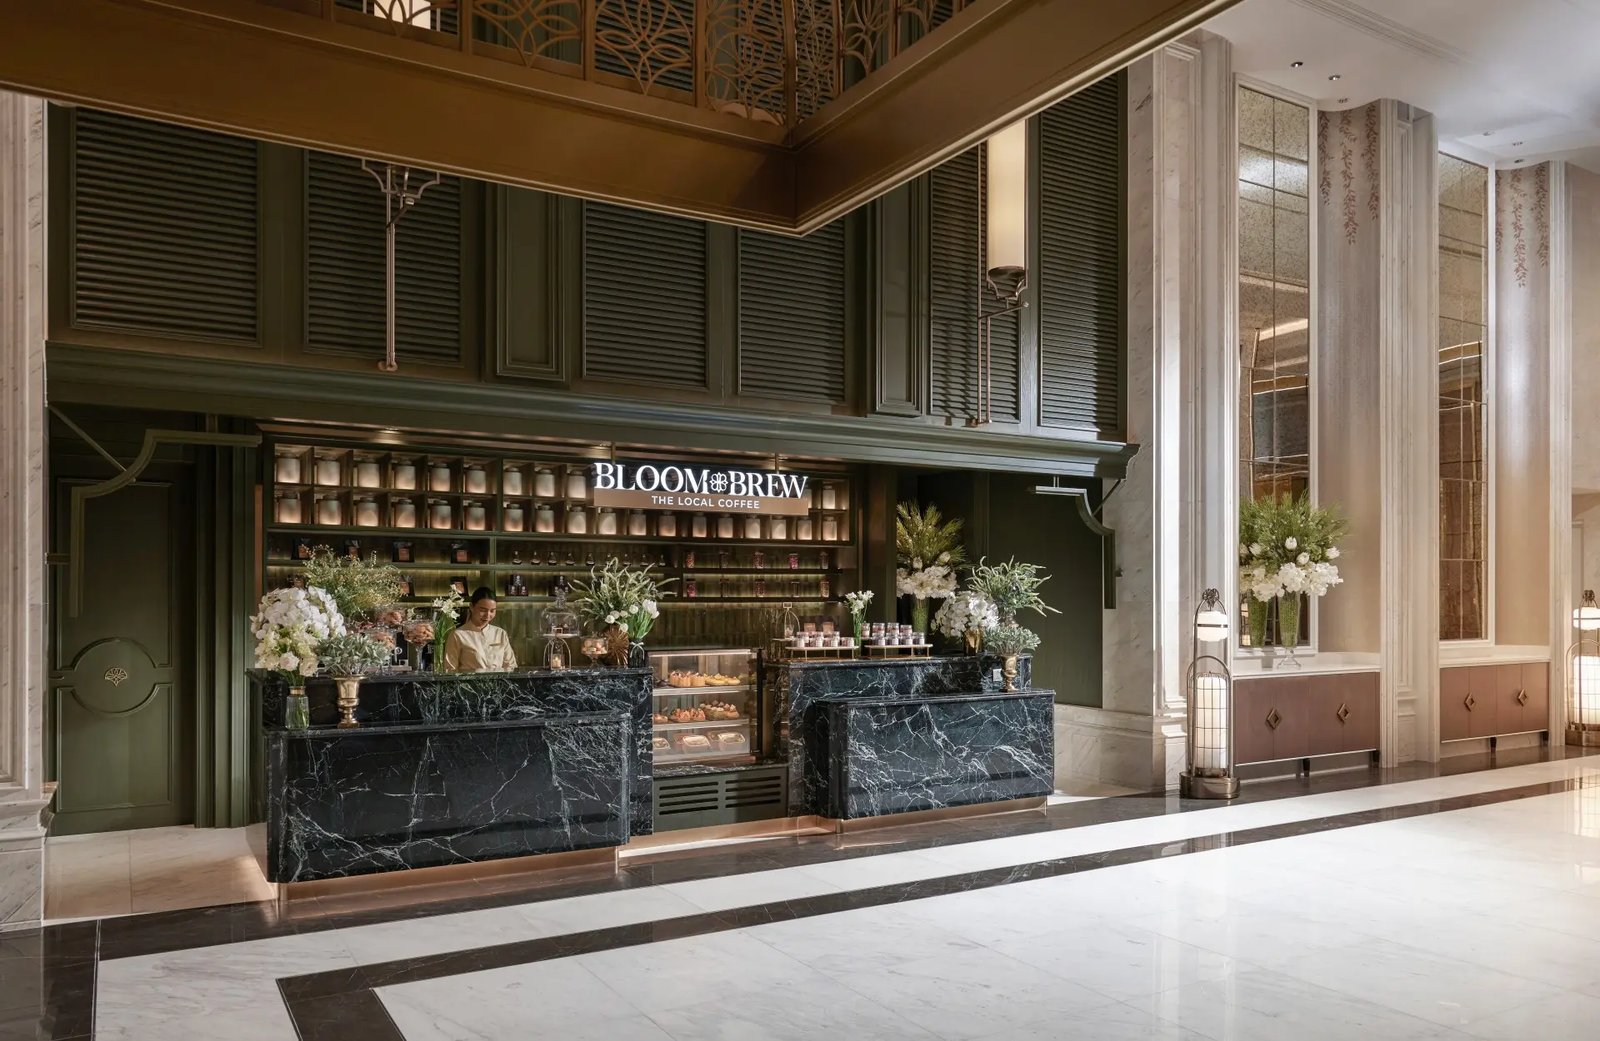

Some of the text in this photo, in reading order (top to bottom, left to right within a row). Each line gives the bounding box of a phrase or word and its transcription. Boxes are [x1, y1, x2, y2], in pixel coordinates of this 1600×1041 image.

[594, 462, 808, 498] BLOOM BREW
[651, 495, 760, 509] THE LOCAL COFFEE
